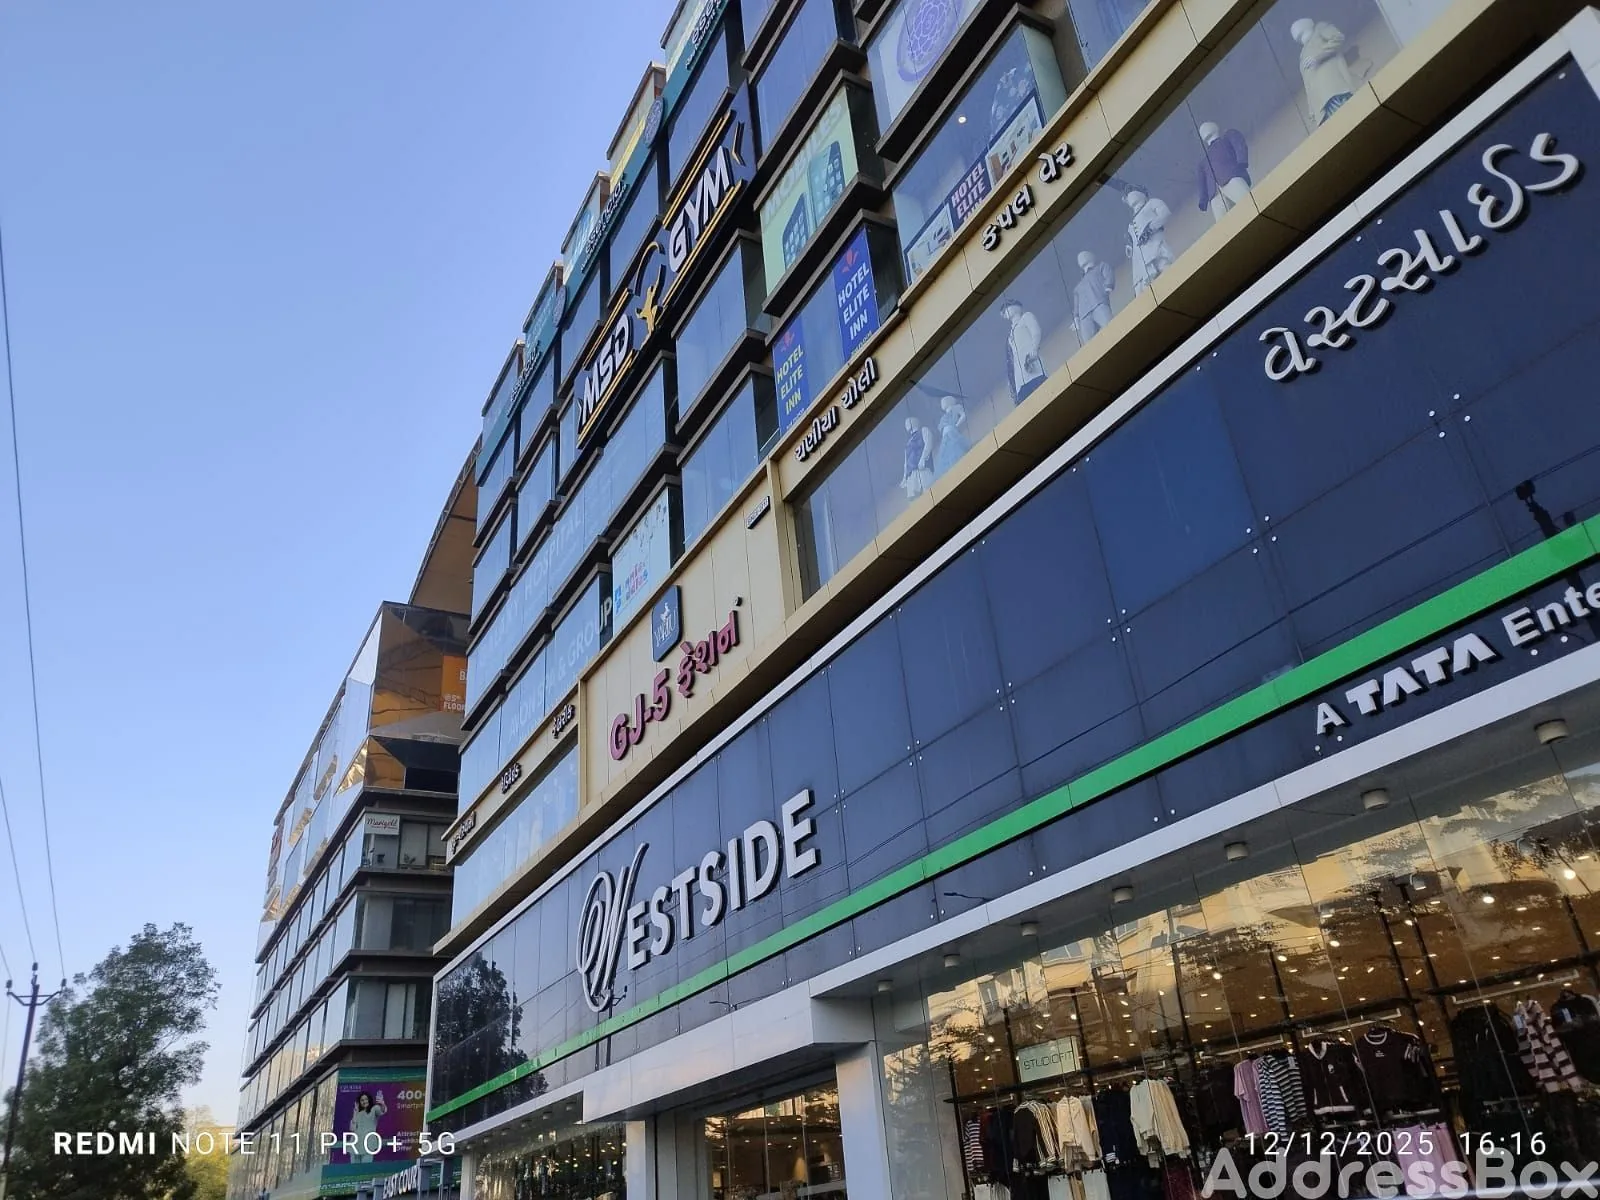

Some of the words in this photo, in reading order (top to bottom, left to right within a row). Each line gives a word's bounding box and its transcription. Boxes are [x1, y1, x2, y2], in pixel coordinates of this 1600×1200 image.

[951, 160, 985, 208] HOTEL
[956, 177, 986, 220] ELITE
[983, 184, 1032, 251] કપલ
[1038, 142, 1073, 183] વેર
[669, 145, 731, 273] GYM
[1259, 133, 1579, 381] વેસ્ટસાઈડ
[838, 261, 870, 308] HOTEL
[843, 283, 870, 325] ELITE
[849, 309, 868, 341] INN
[581, 313, 633, 426] MSD
[776, 343, 804, 385] HOTEL
[780, 364, 804, 399] ELITE
[785, 387, 802, 416] INN
[568, 596, 613, 668] GROUP
[1317, 702, 1346, 736] A
[1345, 632, 1497, 716] TATA
[610, 668, 671, 761] GJ-5
[576, 788, 818, 1012] WESTSIDE
[383, 1171, 398, 1200] EAST
[399, 1165, 418, 1195] COUR
